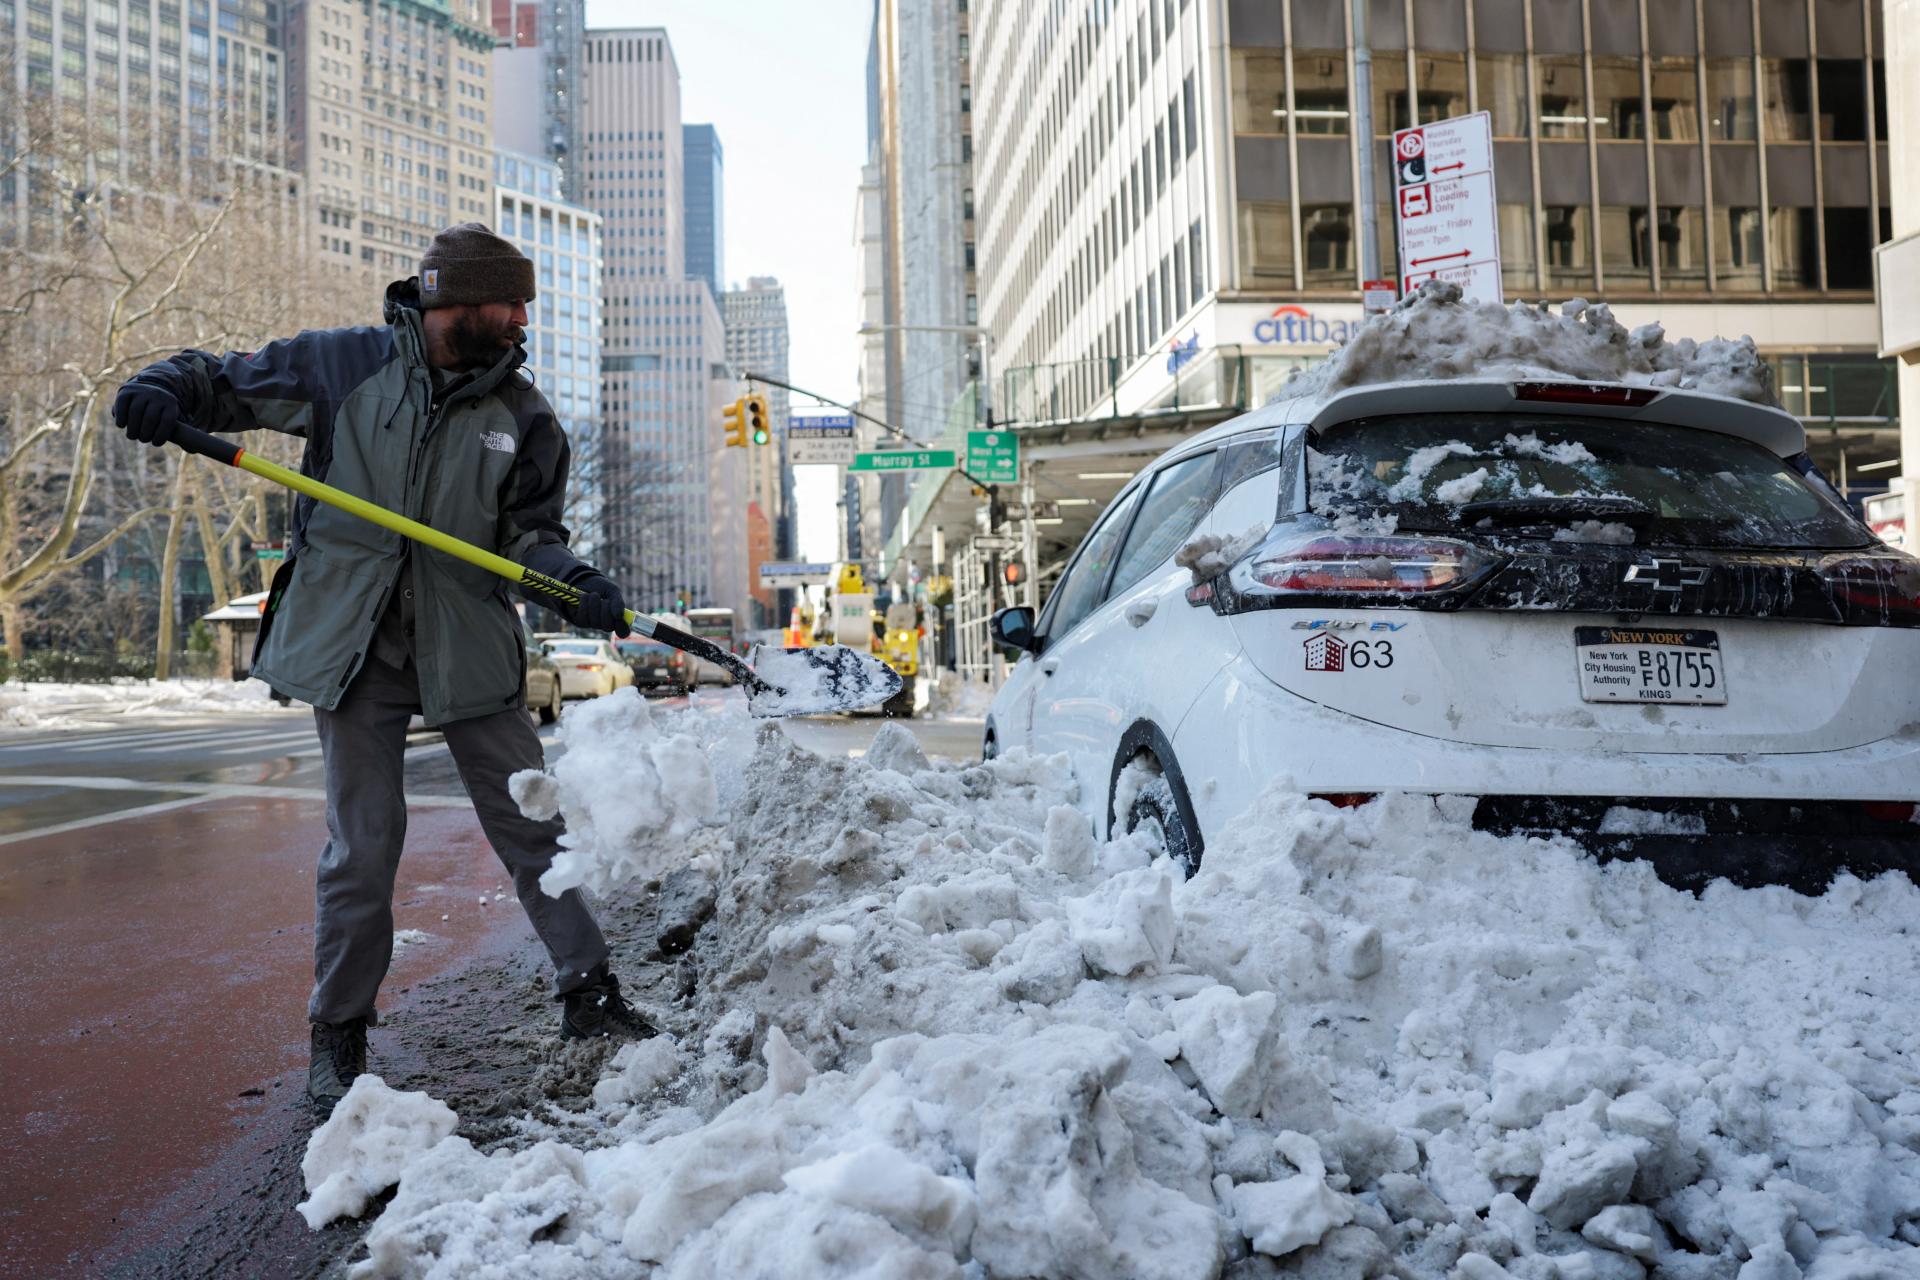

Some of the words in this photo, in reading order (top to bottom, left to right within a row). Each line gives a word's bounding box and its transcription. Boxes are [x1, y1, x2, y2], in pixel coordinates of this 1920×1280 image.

[1428, 136, 1462, 149] Thursday
[1435, 183, 1458, 193] Truck
[1435, 190, 1469, 203] Loading
[1435, 203, 1455, 213] Only
[1406, 225, 1437, 236] Monday
[1447, 217, 1473, 229] Friday
[803, 417, 823, 428] BUS
[791, 428, 822, 438] BUSES
[825, 428, 849, 437] ONLY
[872, 455, 914, 469] Murray
[918, 453, 930, 465] St
[1370, 622, 1408, 632] EV
[1609, 631, 1645, 644] NEW
[1647, 632, 1685, 645] YORK
[1350, 640, 1394, 668] 63
[1589, 651, 1606, 660] New
[1609, 651, 1628, 660] York
[1584, 663, 1600, 673] City
[1603, 664, 1636, 674] Housing
[1656, 651, 1716, 688] 8755
[1593, 675, 1631, 686] Authority
[1639, 690, 1672, 699] KINGS
